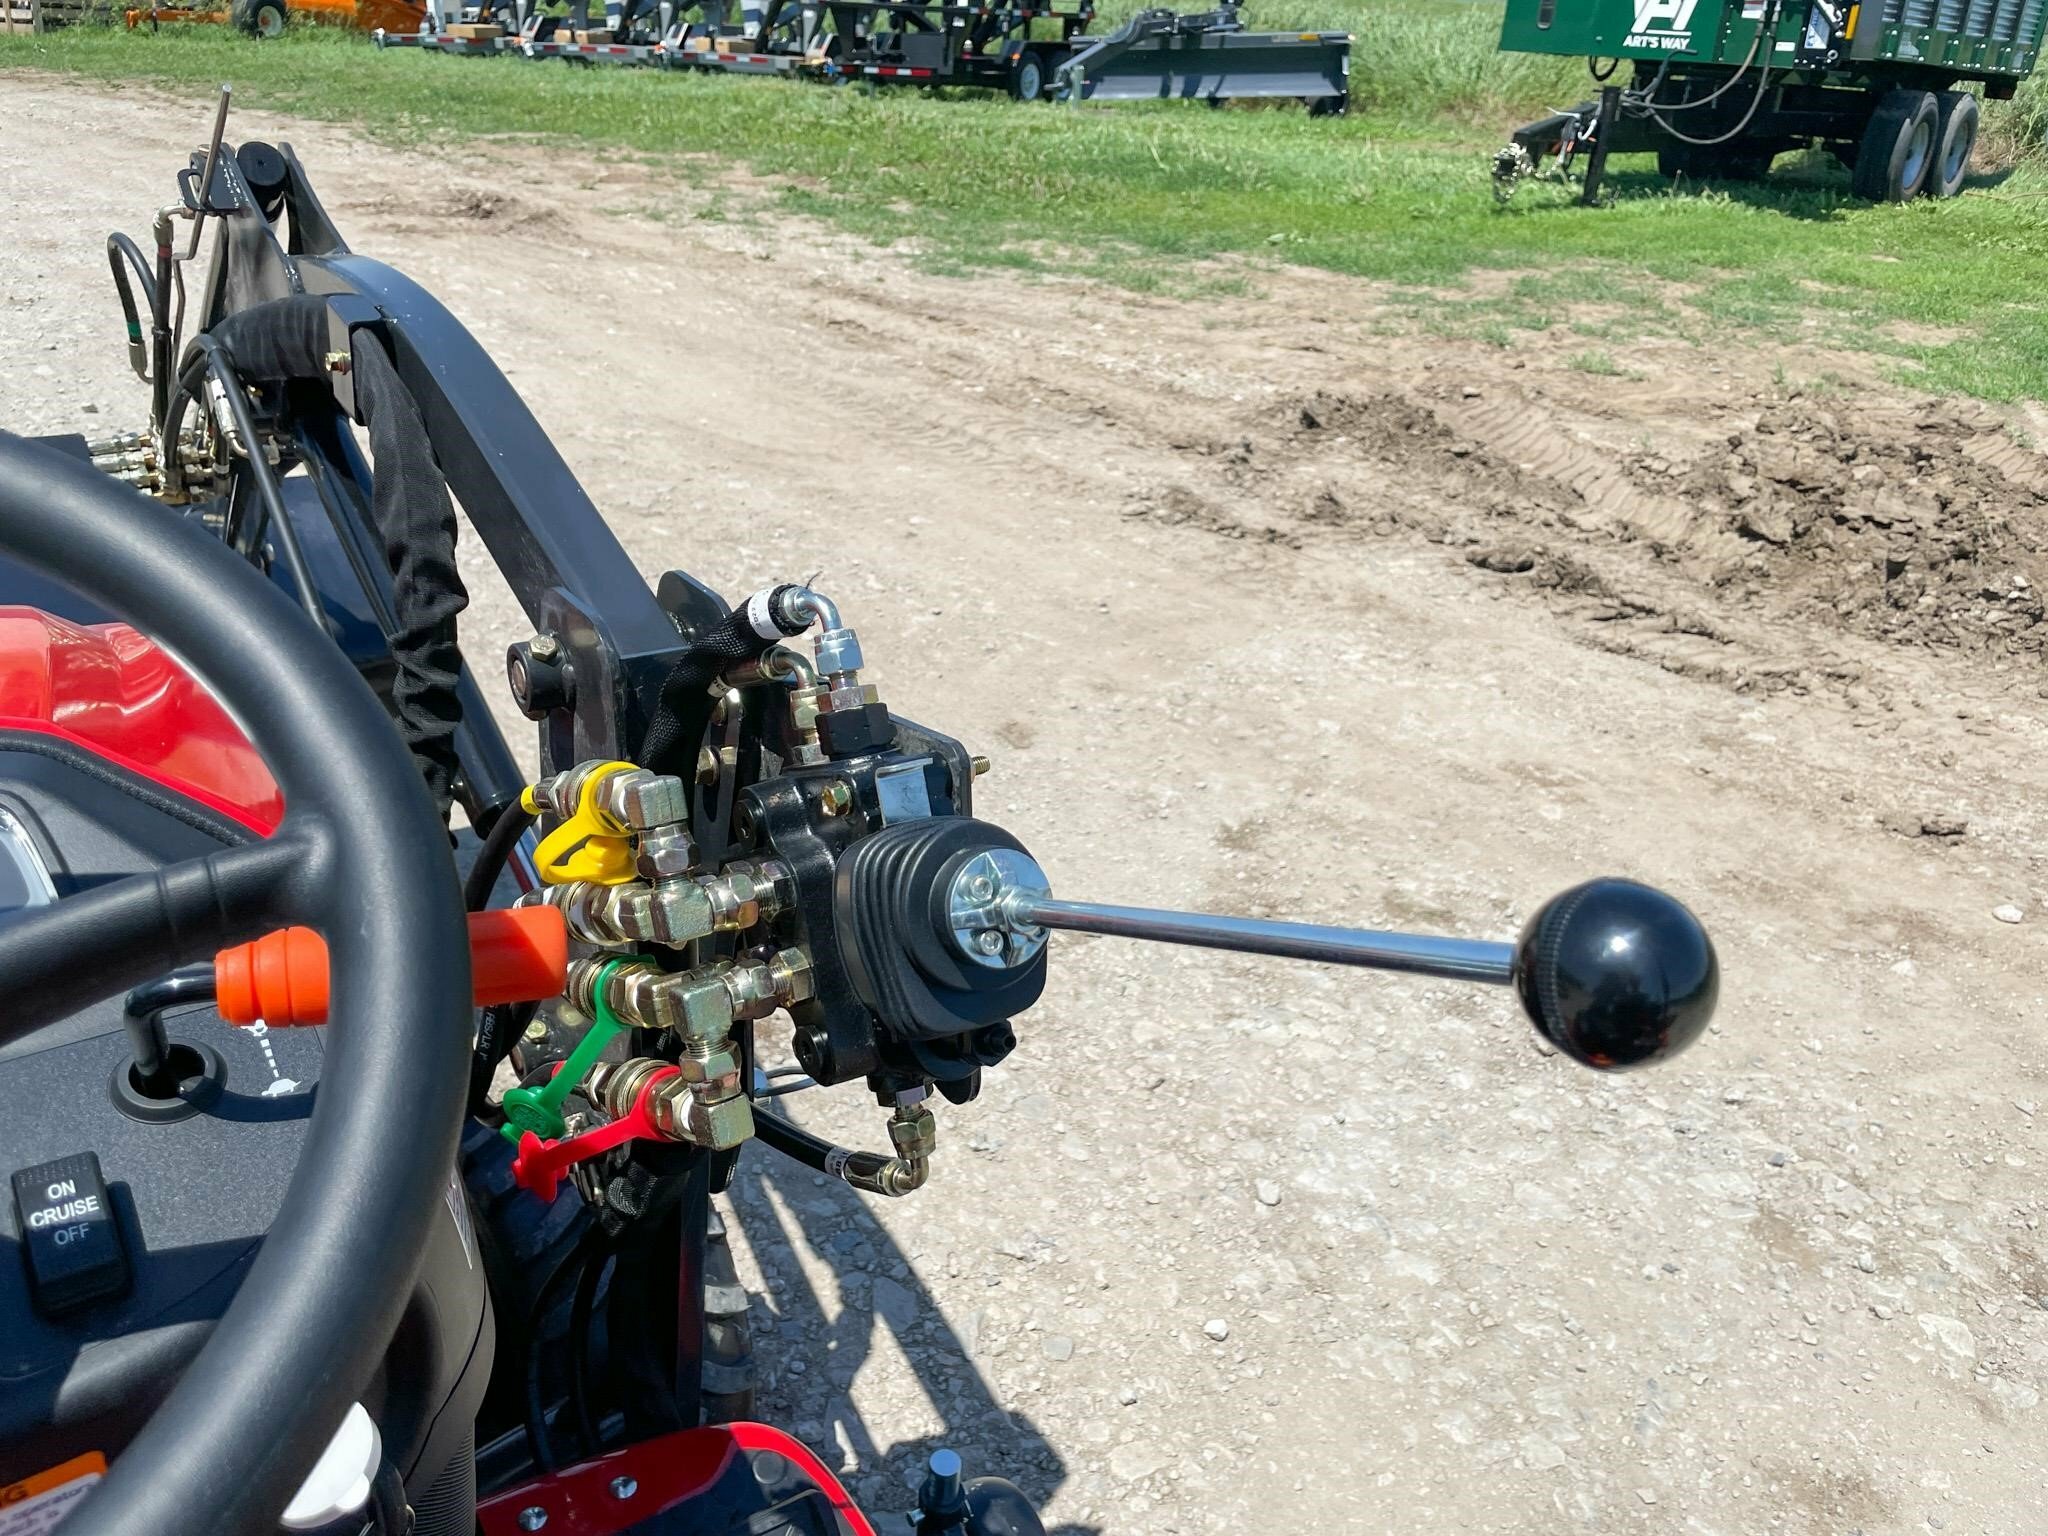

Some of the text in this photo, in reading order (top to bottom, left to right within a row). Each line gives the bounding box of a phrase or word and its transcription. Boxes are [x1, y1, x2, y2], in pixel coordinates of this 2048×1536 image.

[1660, 37, 1691, 50] WAY
[47, 1179, 76, 1200] ON
[30, 1195, 100, 1228] CRUISE
[54, 1222, 90, 1246] OFF
